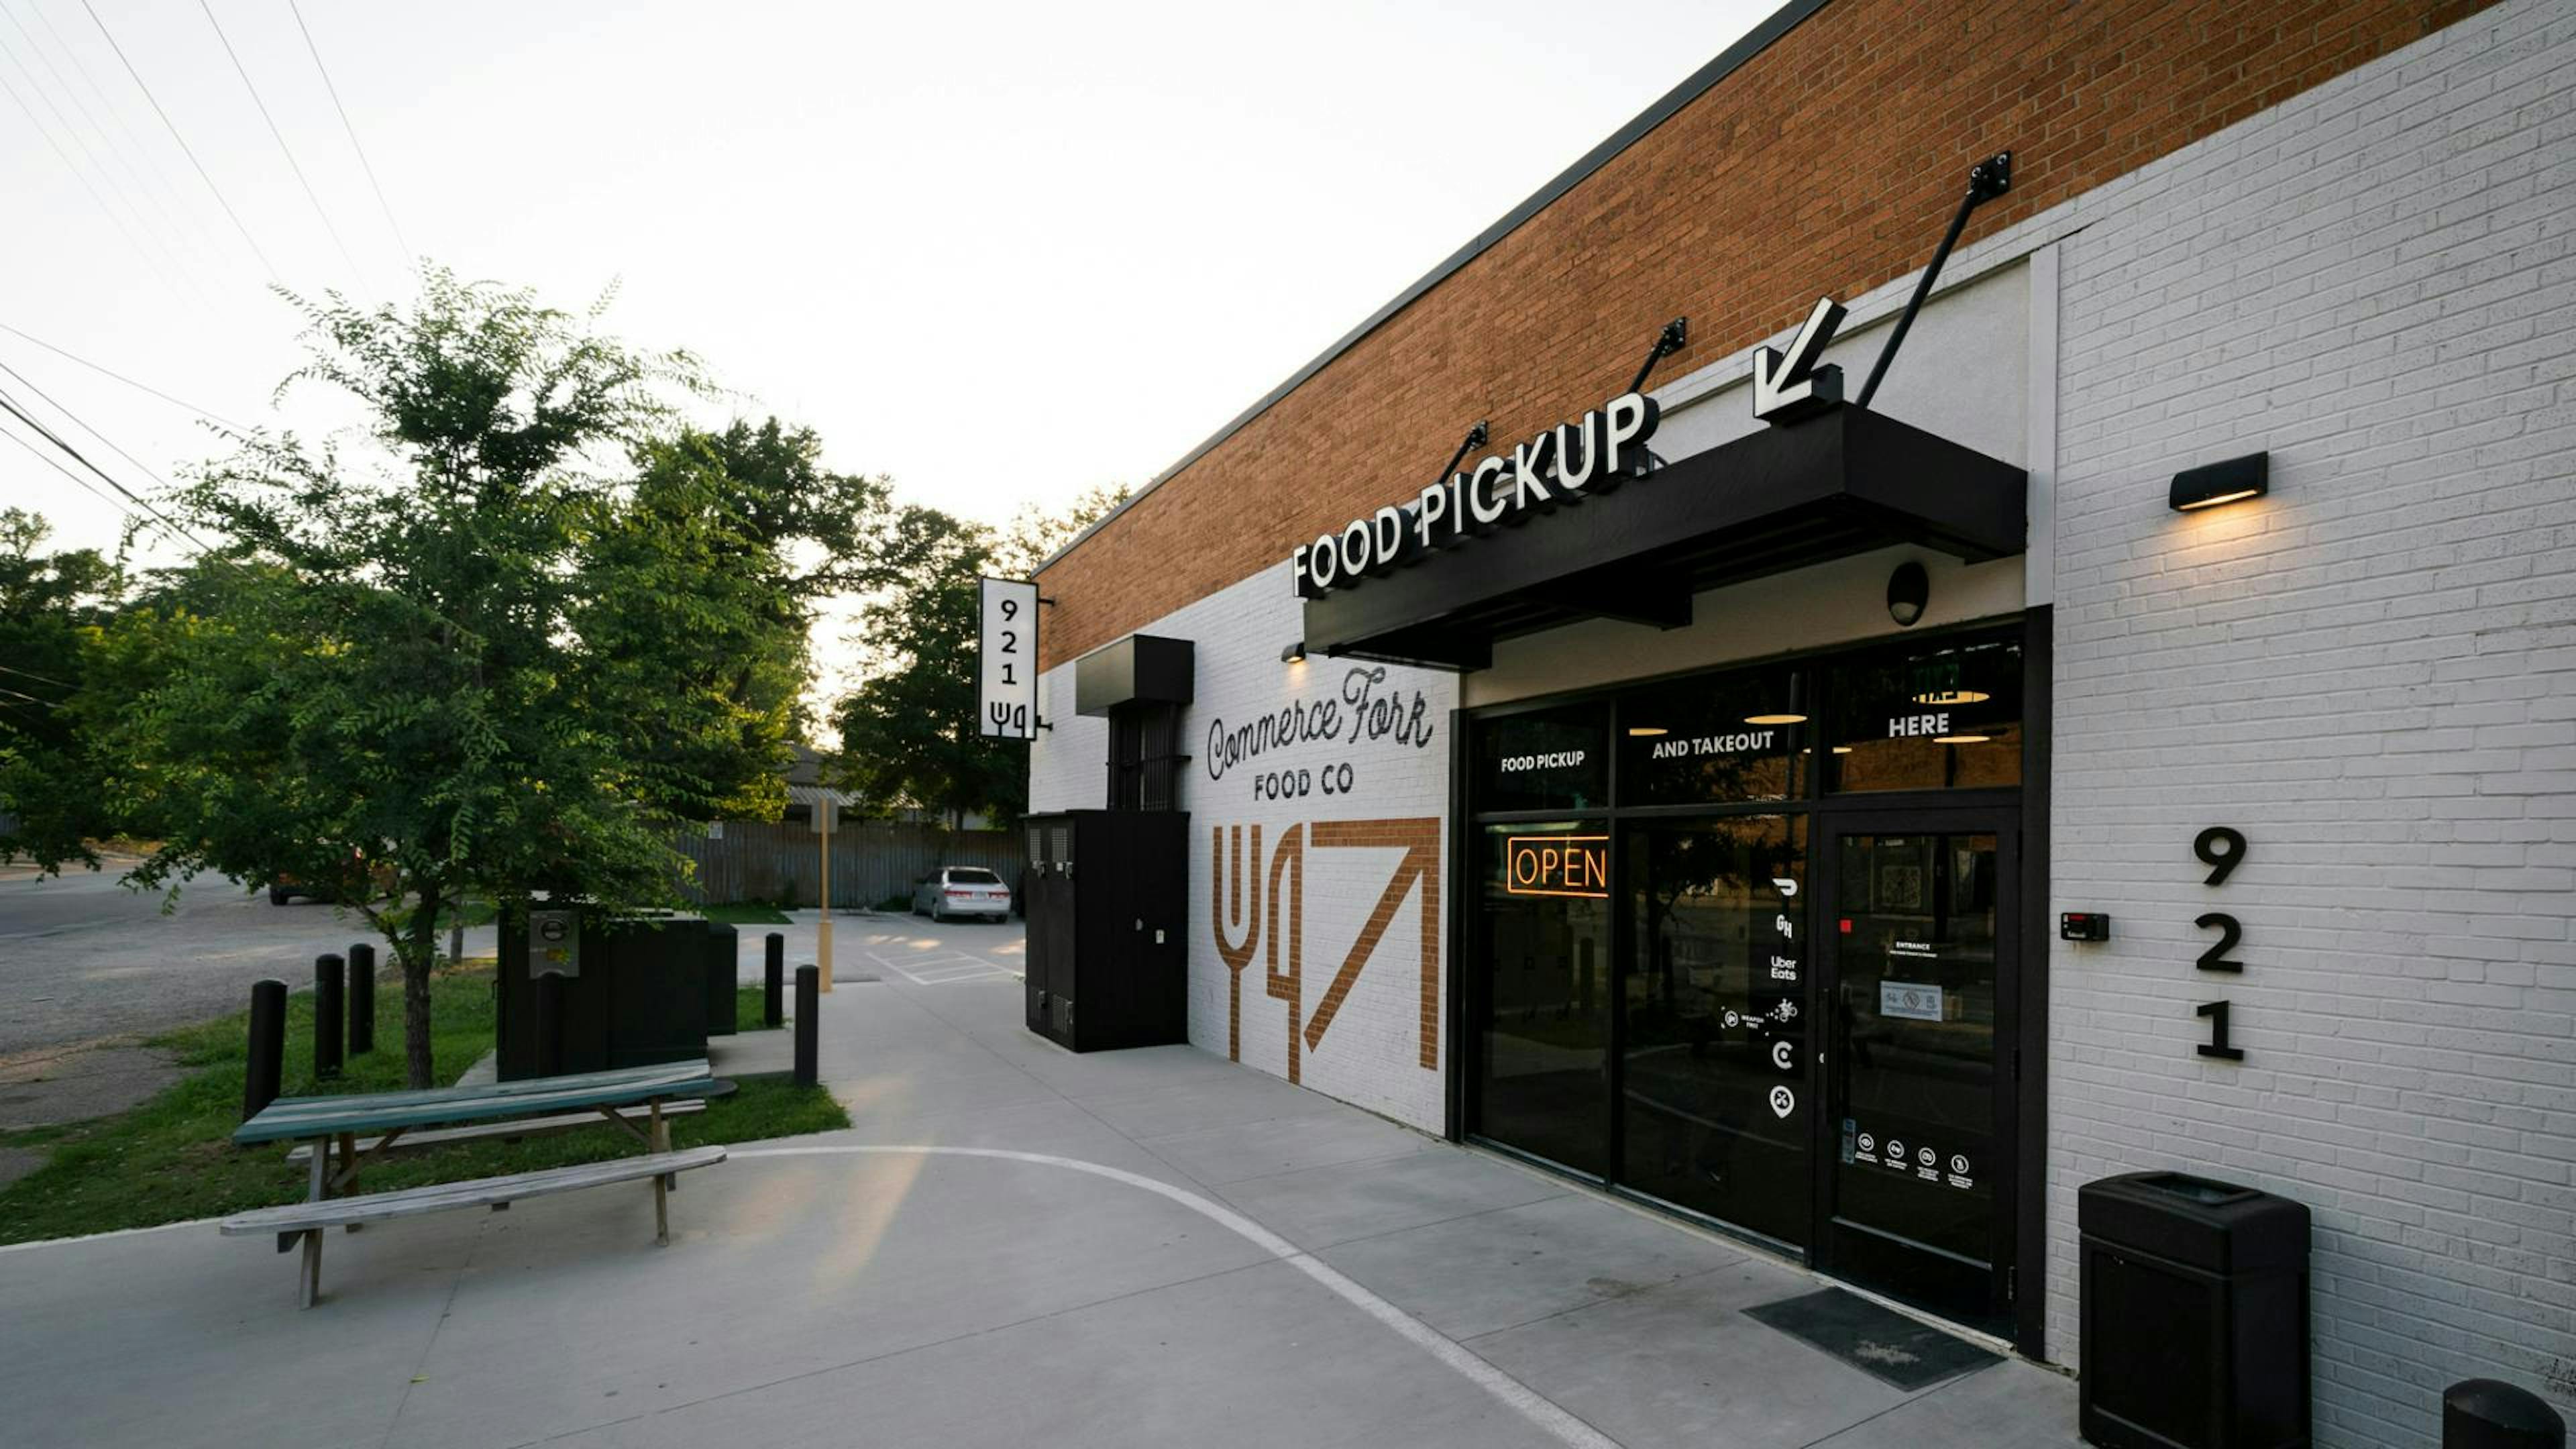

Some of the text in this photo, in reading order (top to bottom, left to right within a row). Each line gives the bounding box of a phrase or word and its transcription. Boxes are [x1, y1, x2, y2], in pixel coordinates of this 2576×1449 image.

[1293, 392, 1646, 598] FOOD PICKUP
[1208, 666, 1434, 781] Commerce Fork
[1888, 712, 1949, 738] HERE
[1652, 731, 1774, 759] AND TAKEOUT
[1501, 751, 1585, 773] FOOD PICKUP
[1254, 762, 1354, 801] FOOD CO
[1515, 848, 1606, 888] OPEN
[1896, 941, 1931, 951] ENTRANCE
[2193, 826, 2247, 1062] 921
[1770, 956, 1797, 969] Uber
[1770, 967, 1796, 981] Eats
